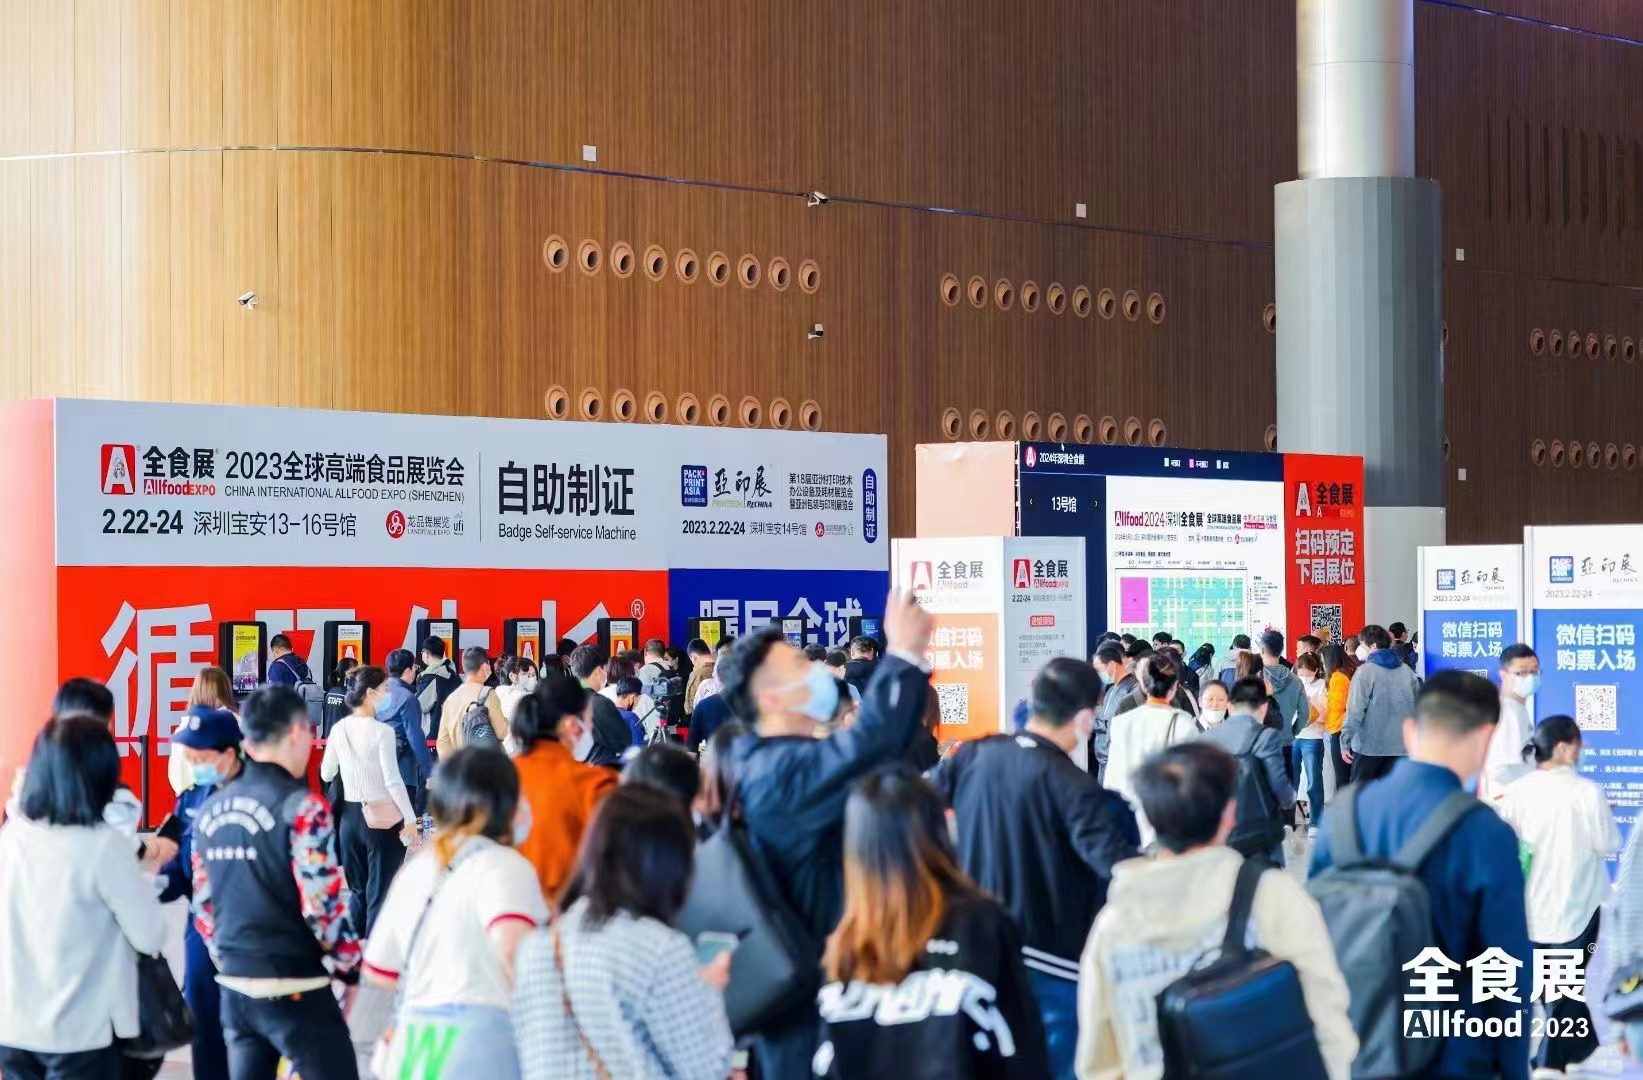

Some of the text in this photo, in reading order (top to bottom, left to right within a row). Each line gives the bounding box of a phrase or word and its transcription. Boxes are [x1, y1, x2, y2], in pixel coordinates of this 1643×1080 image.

[142, 445, 215, 479] 全食展
[225, 450, 465, 486] 2023全球高端食品展览会
[683, 469, 702, 479] PACK
[683, 478, 705, 488] PRINT
[788, 472, 853, 485] 第18届亚洲打印技术
[224, 485, 465, 504] CHINA INTERNATIONAL ALLFOOD EXPO (SHENZHEN)
[498, 460, 635, 516] 自助制证
[683, 486, 701, 496] ASIA
[788, 486, 854, 498] 办公设备及耗材展览会
[1316, 482, 1354, 505] 全食展
[865, 474, 876, 538] 自助制证
[1051, 496, 1077, 514] 13号馆
[102, 508, 184, 535] 2.22-24
[682, 519, 746, 535] 2023.2.22-24
[749, 521, 808, 536] 深圳宝安14号馆
[498, 523, 637, 541] Badge Self-service Machine
[1295, 528, 1355, 556] 扫码预定
[937, 560, 984, 580] 全食展
[1033, 559, 1068, 579] 全食展
[1295, 557, 1356, 585] 下届展位
[1442, 621, 1504, 639] 微信扫码
[1555, 623, 1636, 646] 微信扫码
[1442, 641, 1502, 659] 购票入场
[1556, 650, 1637, 672] 购票入场
